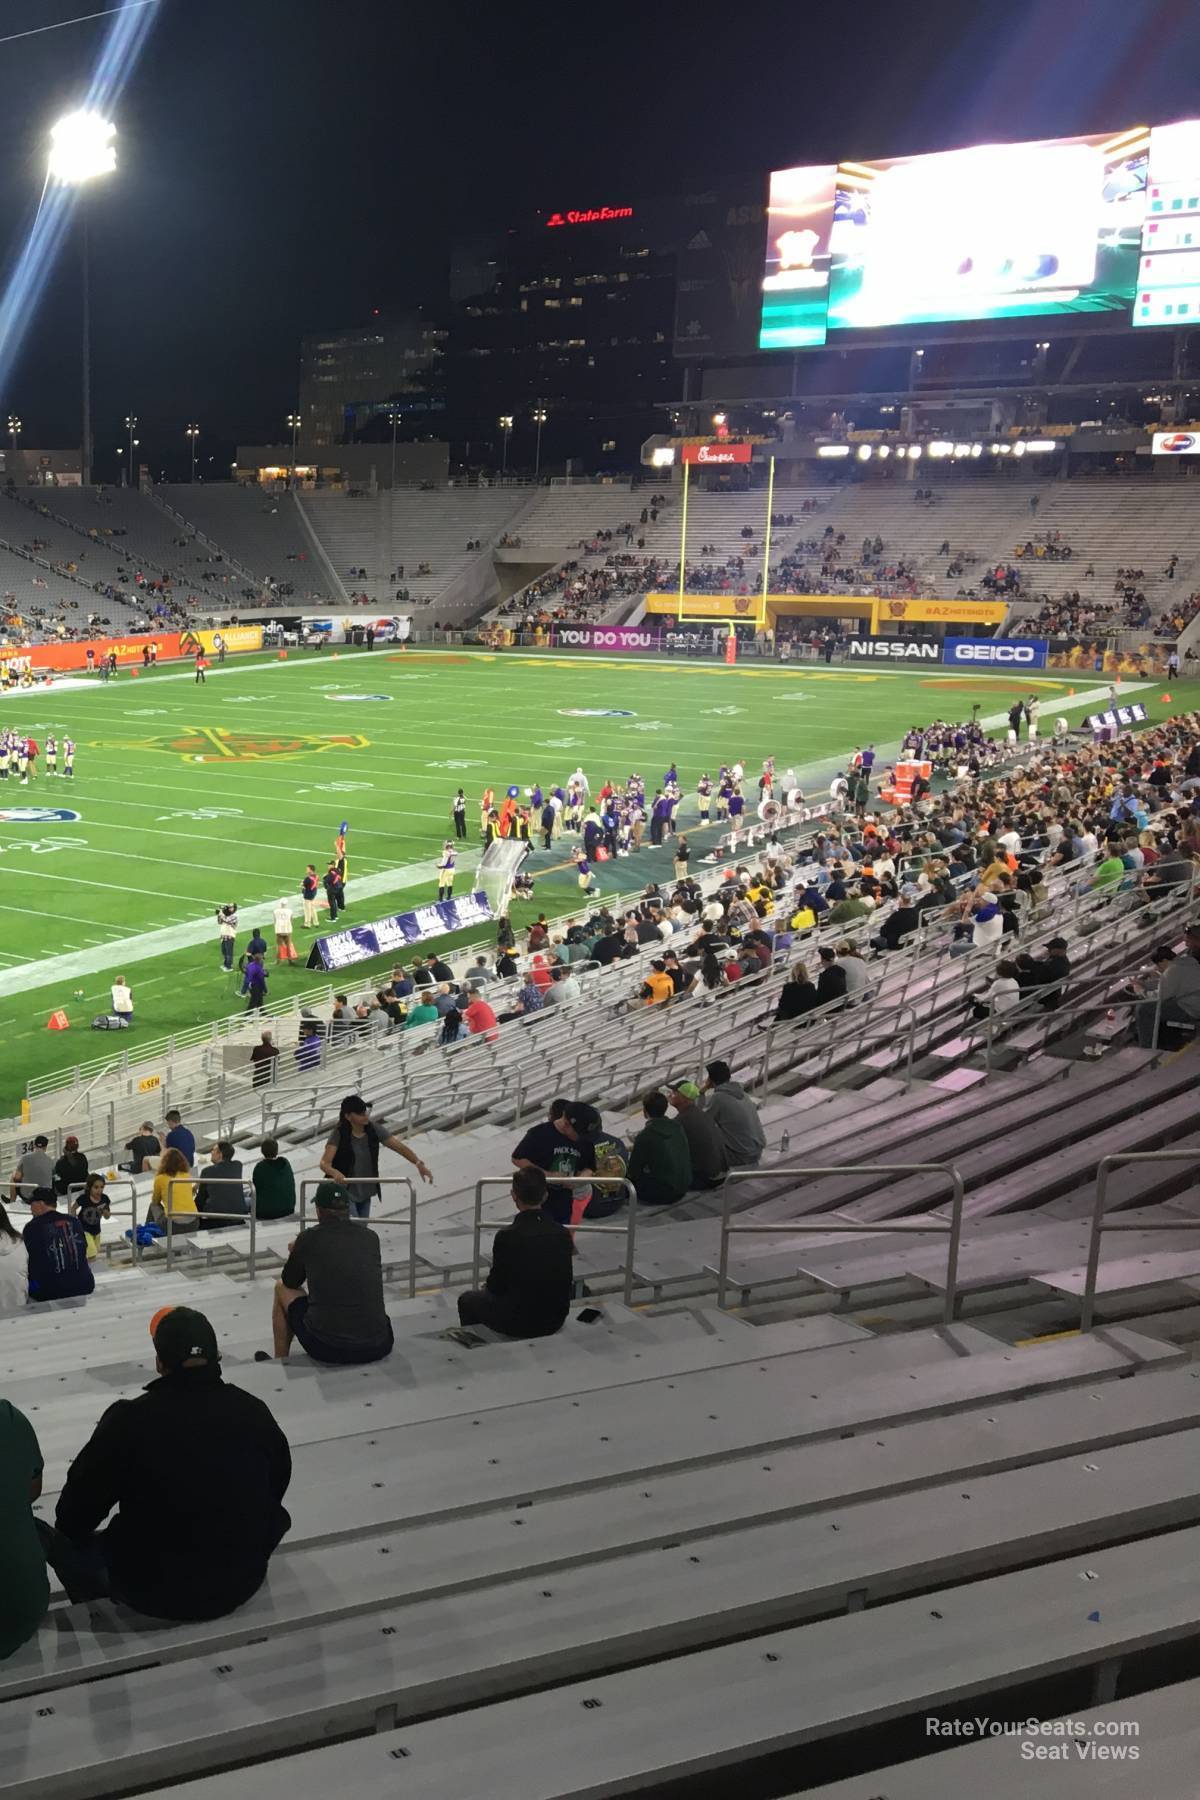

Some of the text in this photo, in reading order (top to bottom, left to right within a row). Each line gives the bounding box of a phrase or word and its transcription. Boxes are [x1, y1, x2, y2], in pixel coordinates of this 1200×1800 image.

[560, 630, 590, 644] YOU
[594, 631, 616, 645] DO
[620, 632, 651, 647] YOU
[851, 641, 939, 658] NISSAN
[955, 644, 1035, 662] GEICO
[21, 1139, 34, 1155] 34
